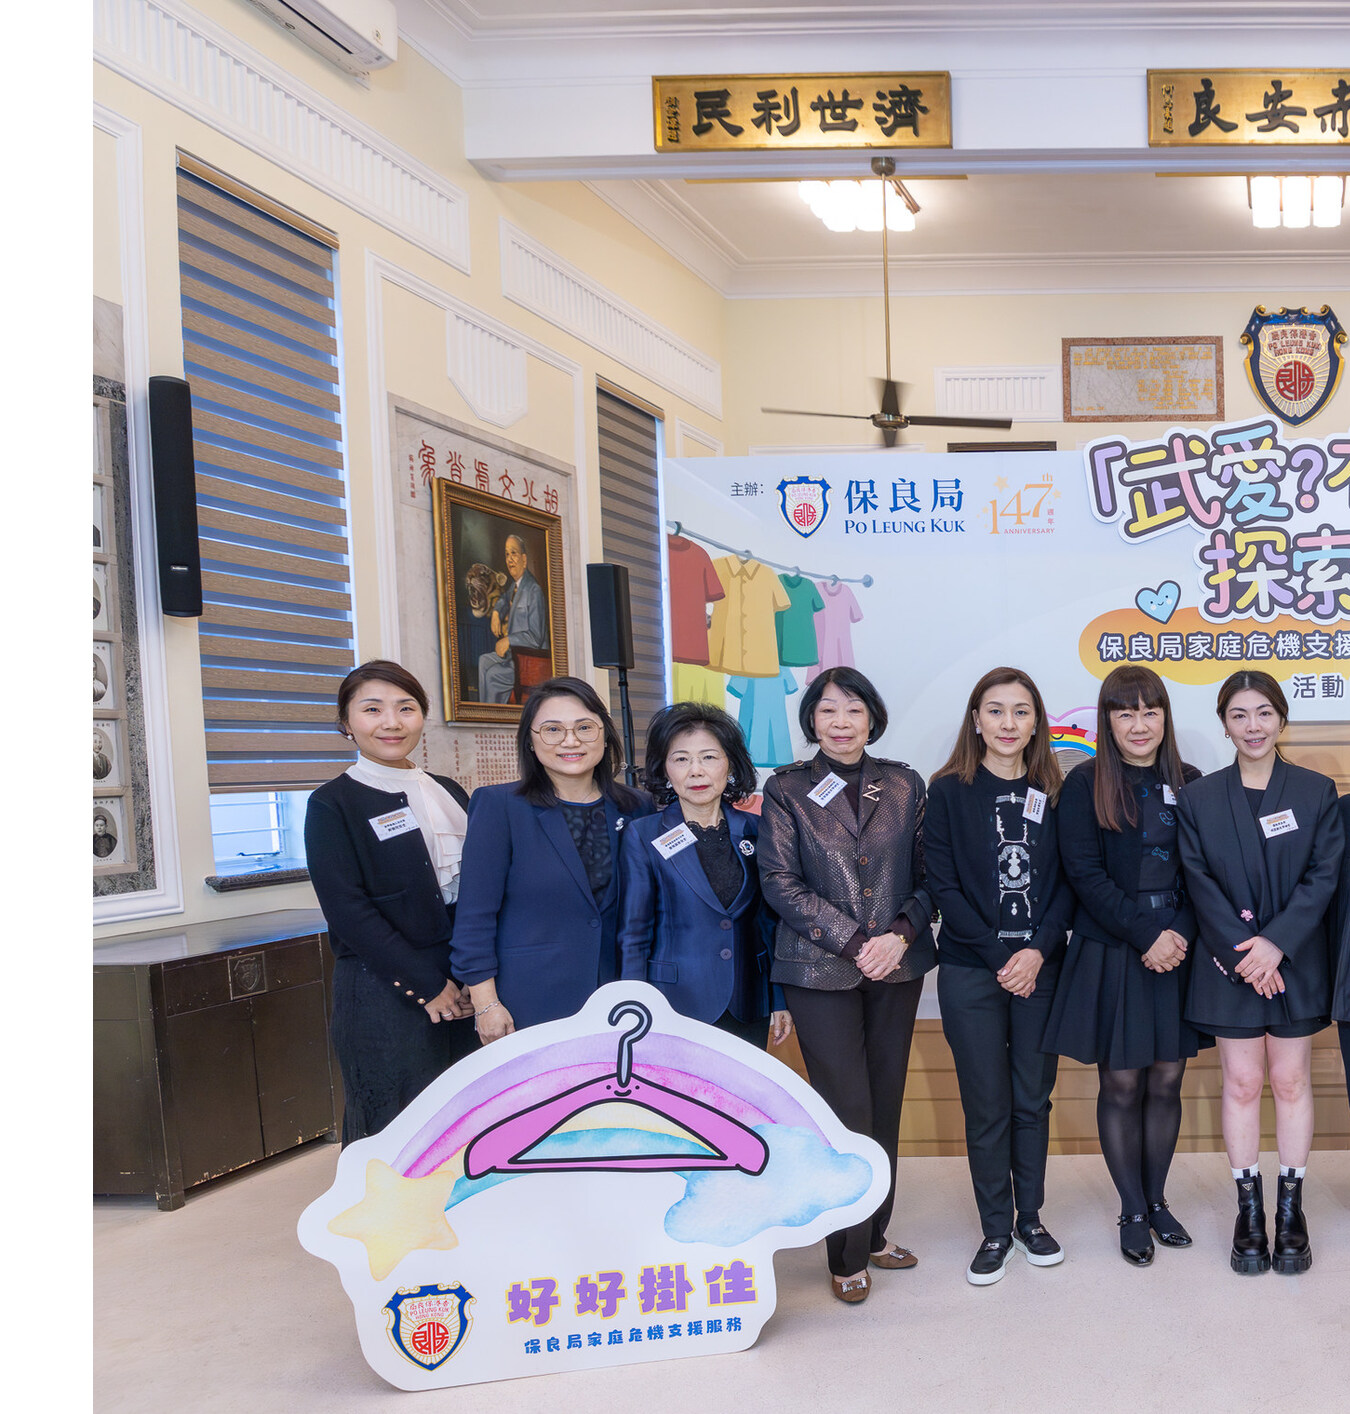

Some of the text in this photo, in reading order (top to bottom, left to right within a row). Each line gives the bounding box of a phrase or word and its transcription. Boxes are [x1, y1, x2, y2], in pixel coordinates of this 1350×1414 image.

[1268, 340, 1321, 350] PO LEUNG KUK
[1275, 347, 1315, 357] HONG KONG
[844, 478, 964, 514] 保良局
[1004, 527, 1055, 535] ANNIVERSARY
[506, 1260, 759, 1327] 好好掛住
[524, 1317, 742, 1354] 保良局家庭危機支援服務
